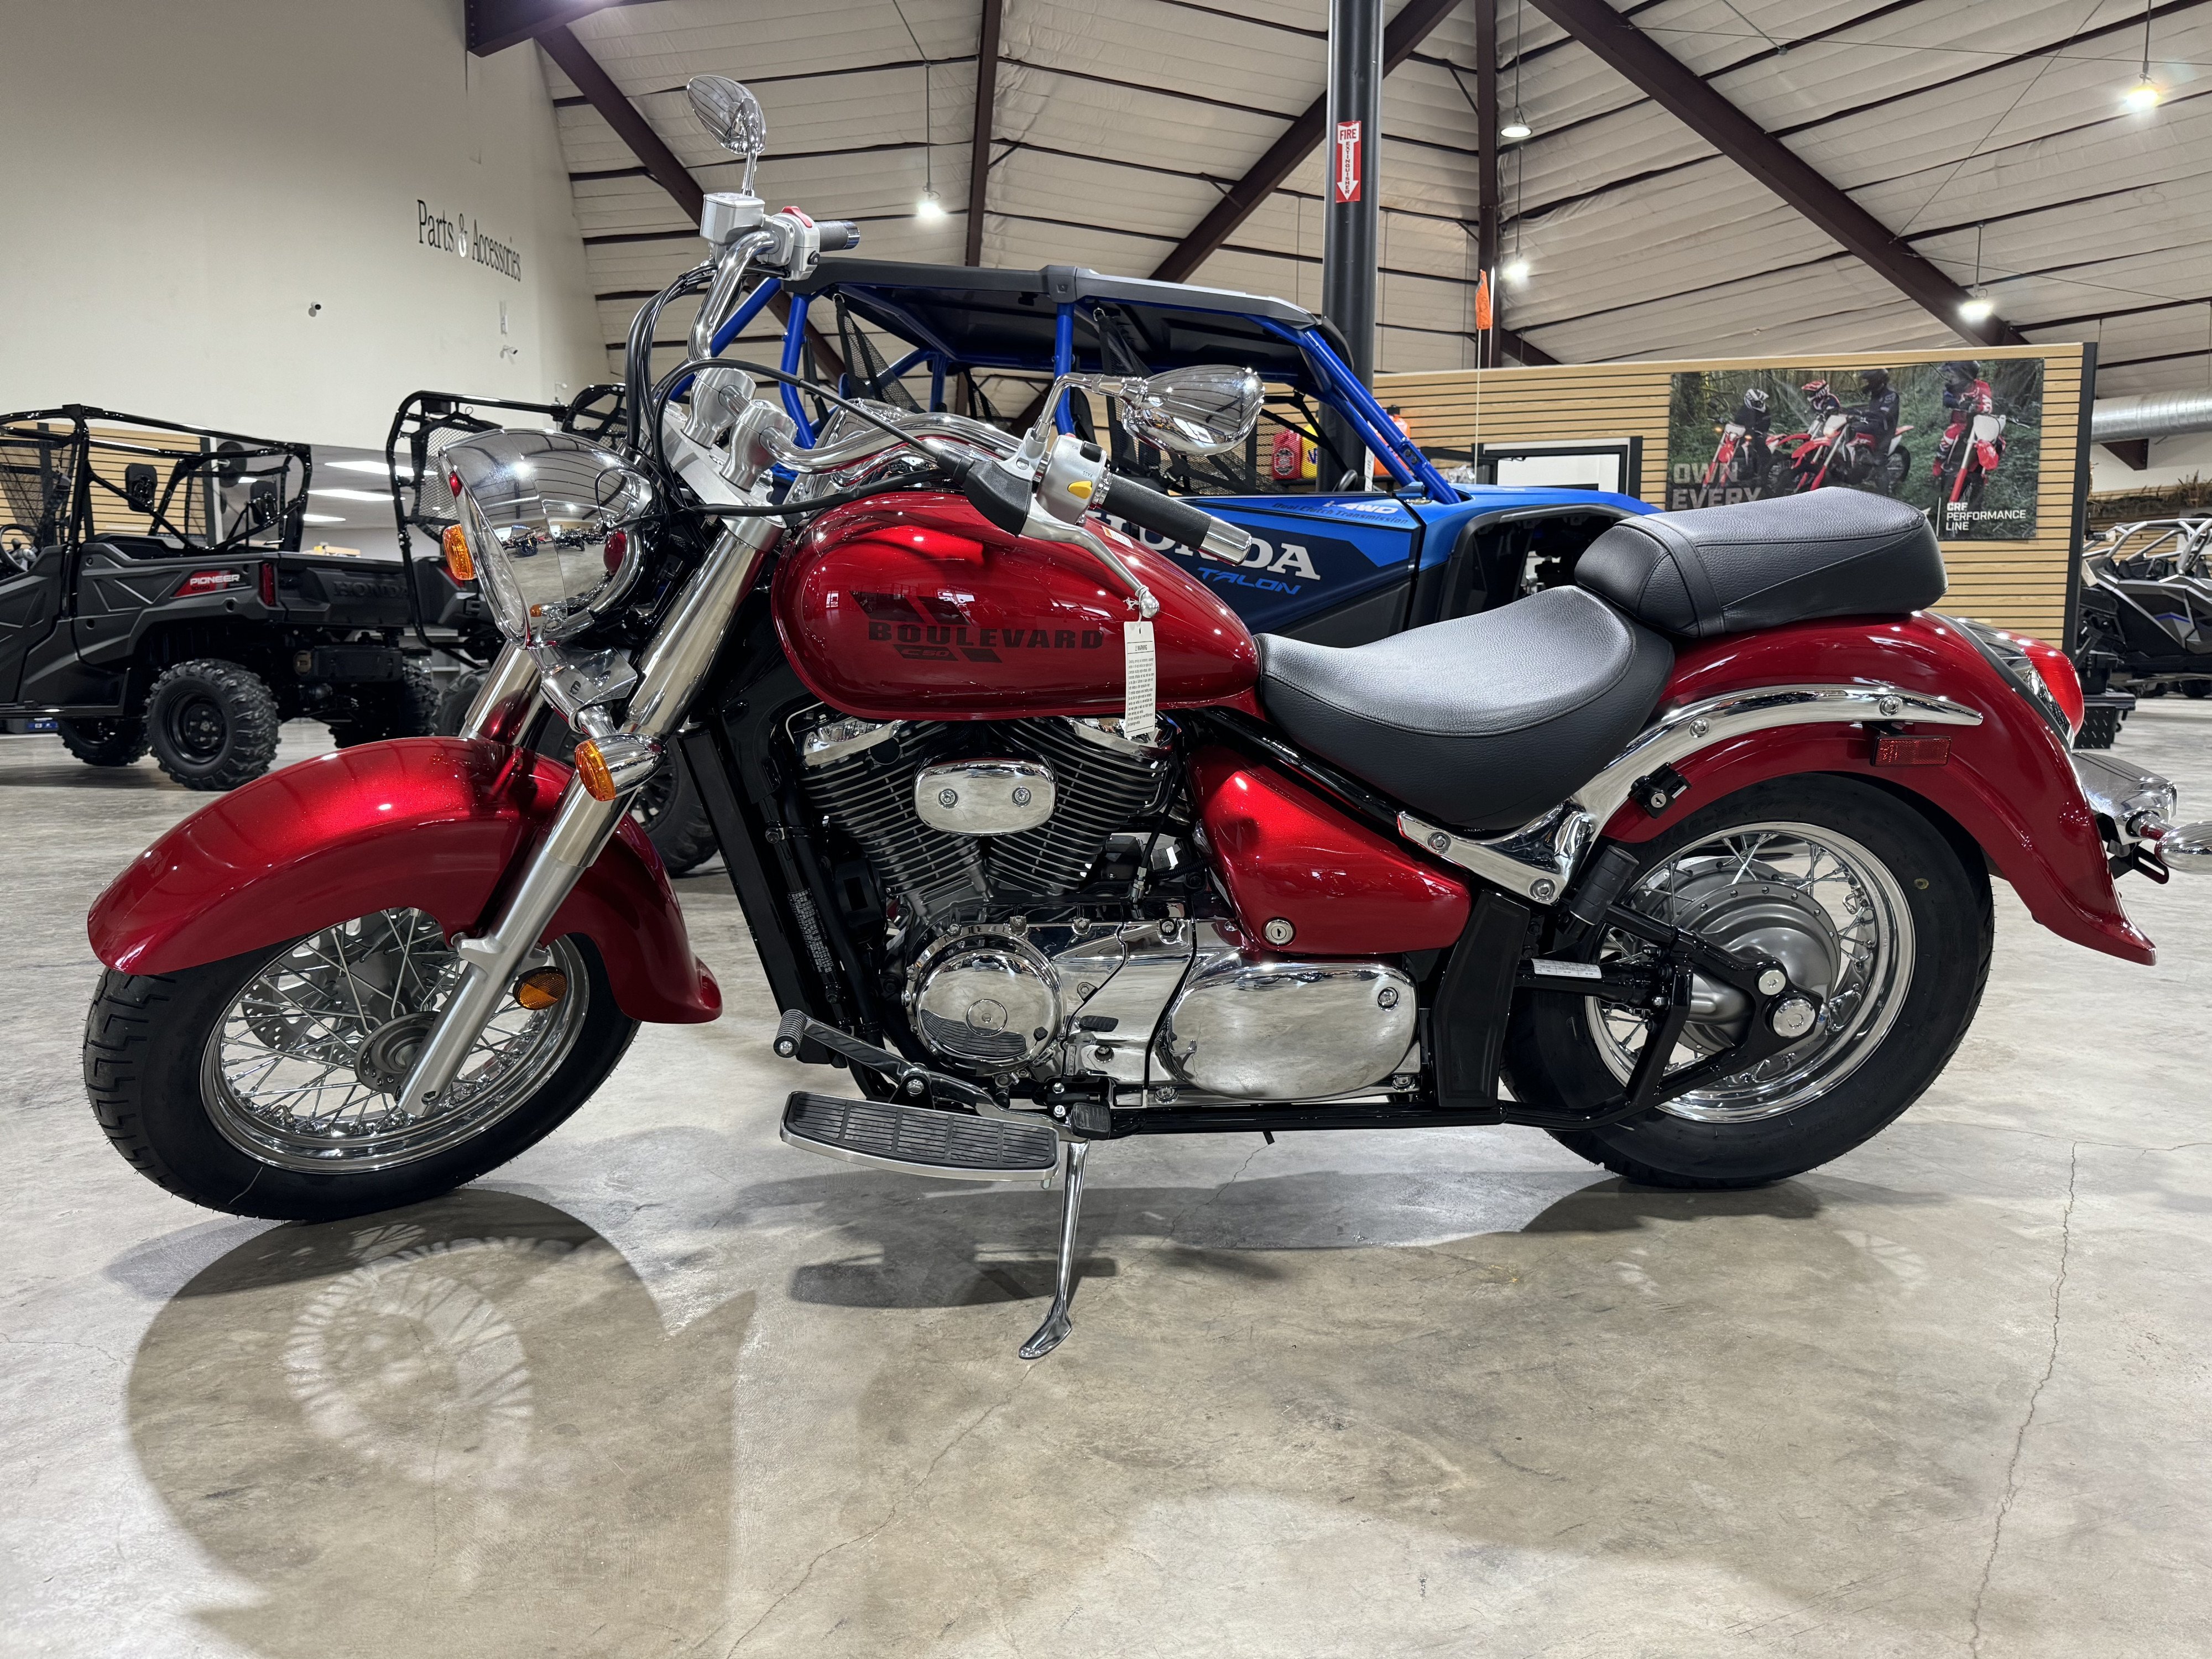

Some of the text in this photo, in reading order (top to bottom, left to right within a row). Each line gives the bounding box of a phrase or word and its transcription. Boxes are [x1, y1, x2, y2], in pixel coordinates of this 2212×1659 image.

[1339, 128, 1357, 140] FIRE
[417, 199, 521, 282] Parts & Accessories
[1673, 461, 1739, 484] OWN
[1672, 487, 1762, 509] EVERY
[1947, 502, 1968, 512] CRF
[1272, 502, 1409, 525] Dual Clutch Transmission
[1946, 510, 2026, 521] PERFORMANCE
[1945, 521, 1969, 531] LINE
[189, 573, 241, 586] PIONEER
[1197, 567, 1301, 594] TALON
[868, 621, 1104, 649] BOULEVARD
